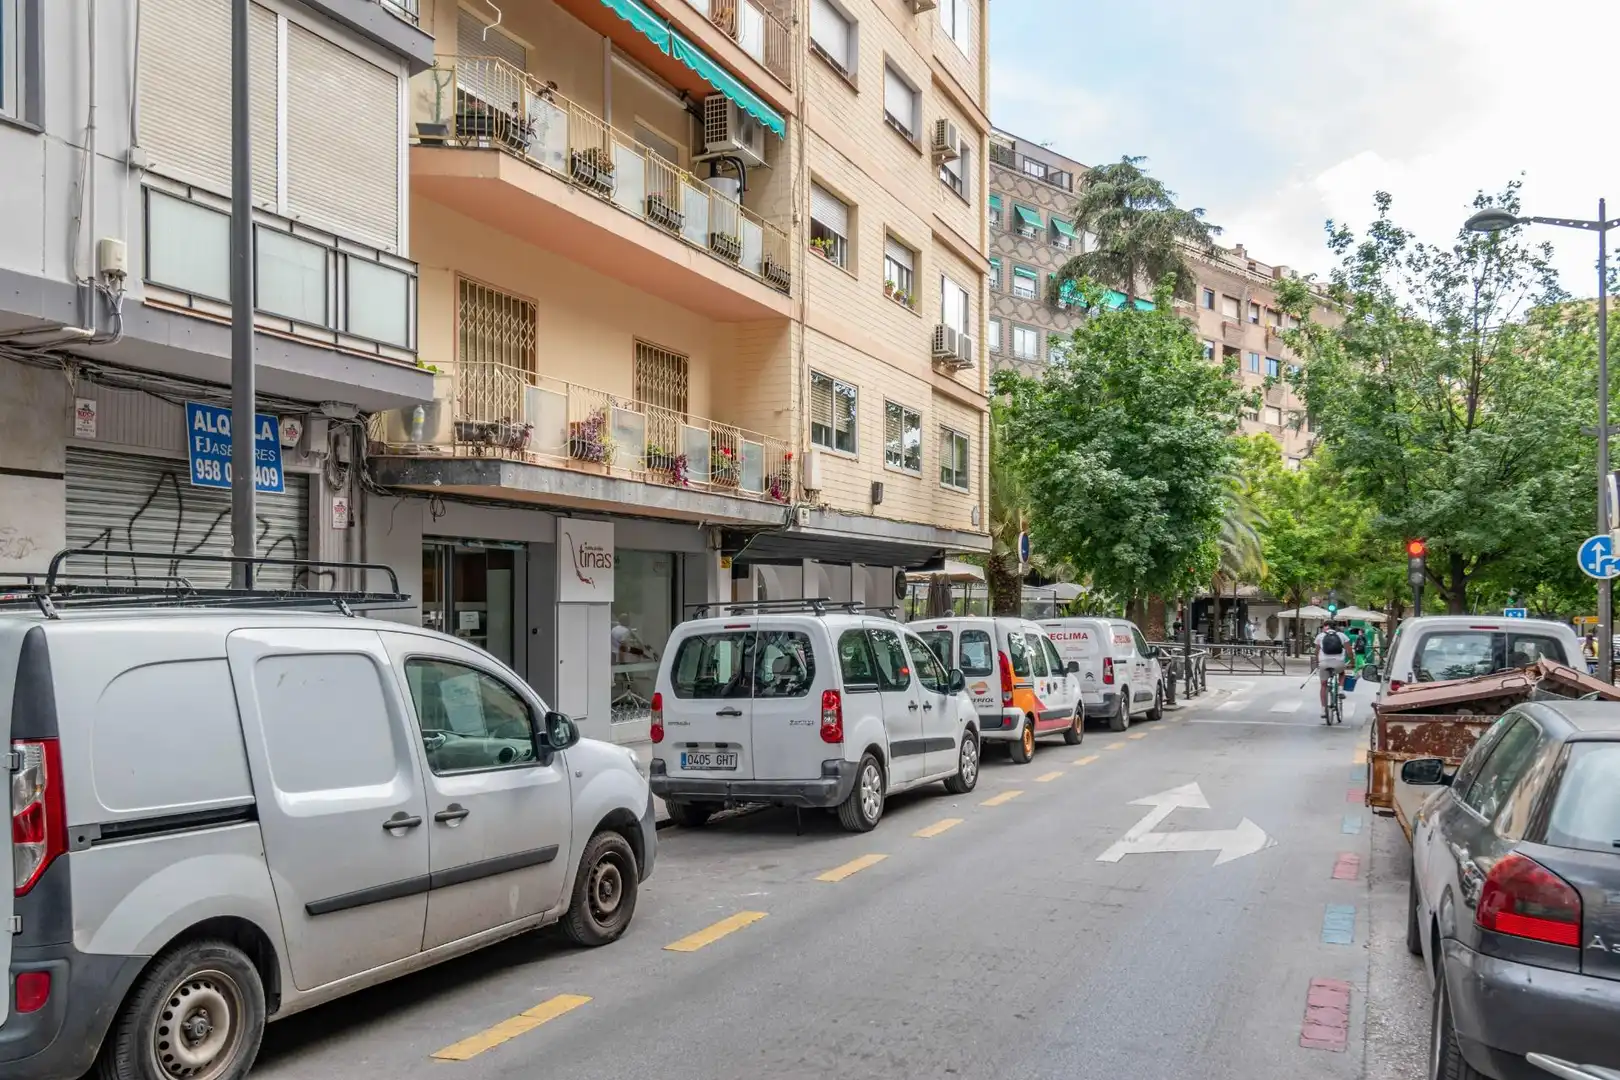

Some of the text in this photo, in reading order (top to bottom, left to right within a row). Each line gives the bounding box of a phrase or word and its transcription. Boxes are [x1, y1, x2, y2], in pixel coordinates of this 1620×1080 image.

[194, 409, 275, 442] ALQA
[196, 458, 221, 481] 958
[579, 542, 612, 569] tinas
[1047, 632, 1089, 641] ECLIMA
[687, 754, 735, 766] 0405 GHT
